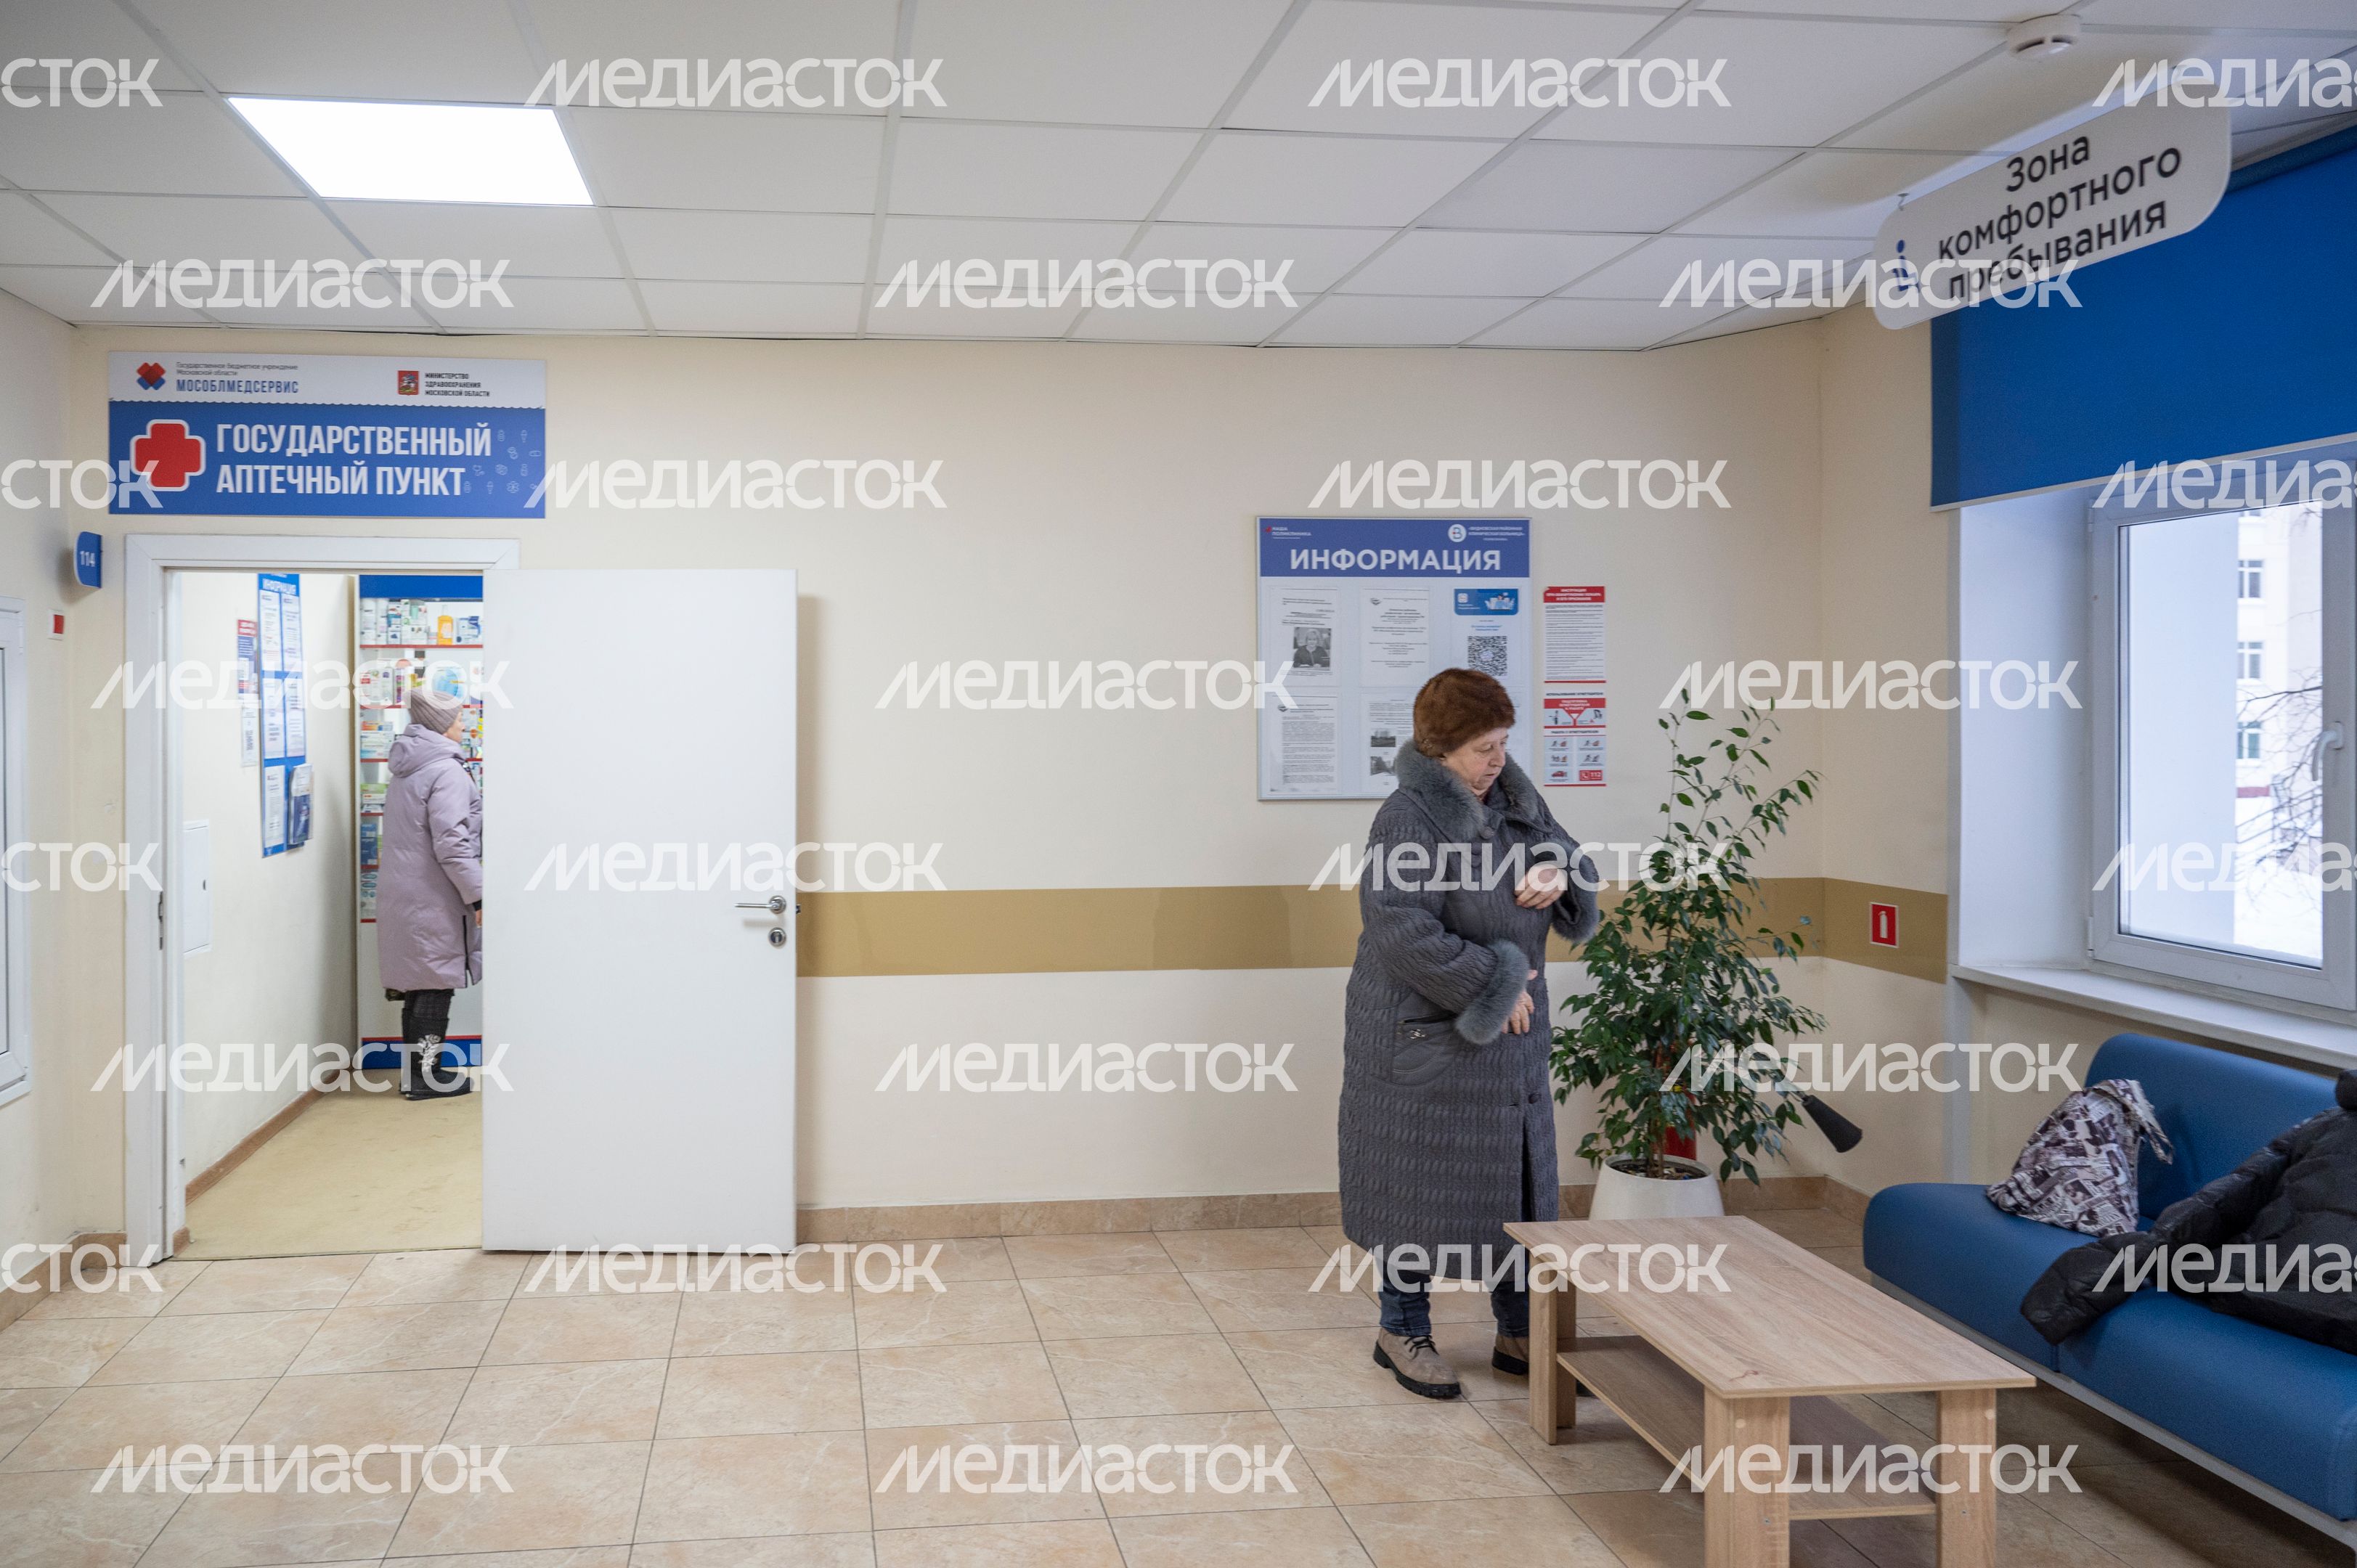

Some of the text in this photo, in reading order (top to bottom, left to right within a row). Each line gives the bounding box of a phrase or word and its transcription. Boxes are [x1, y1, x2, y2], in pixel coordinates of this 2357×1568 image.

[2006, 135, 2091, 192] Зона
[1938, 147, 2182, 264] комфортного
[1948, 200, 2167, 301] пребывания
[176, 379, 299, 393] МОСОБЛМЕДСЕРВИС
[216, 422, 492, 457] ГОСУДАРСТВЕННЫЙ
[216, 460, 466, 496] АПТЕЧНЫЙ ПУНКТ
[1290, 548, 1502, 573] ИНФОРМАЦИЯ
